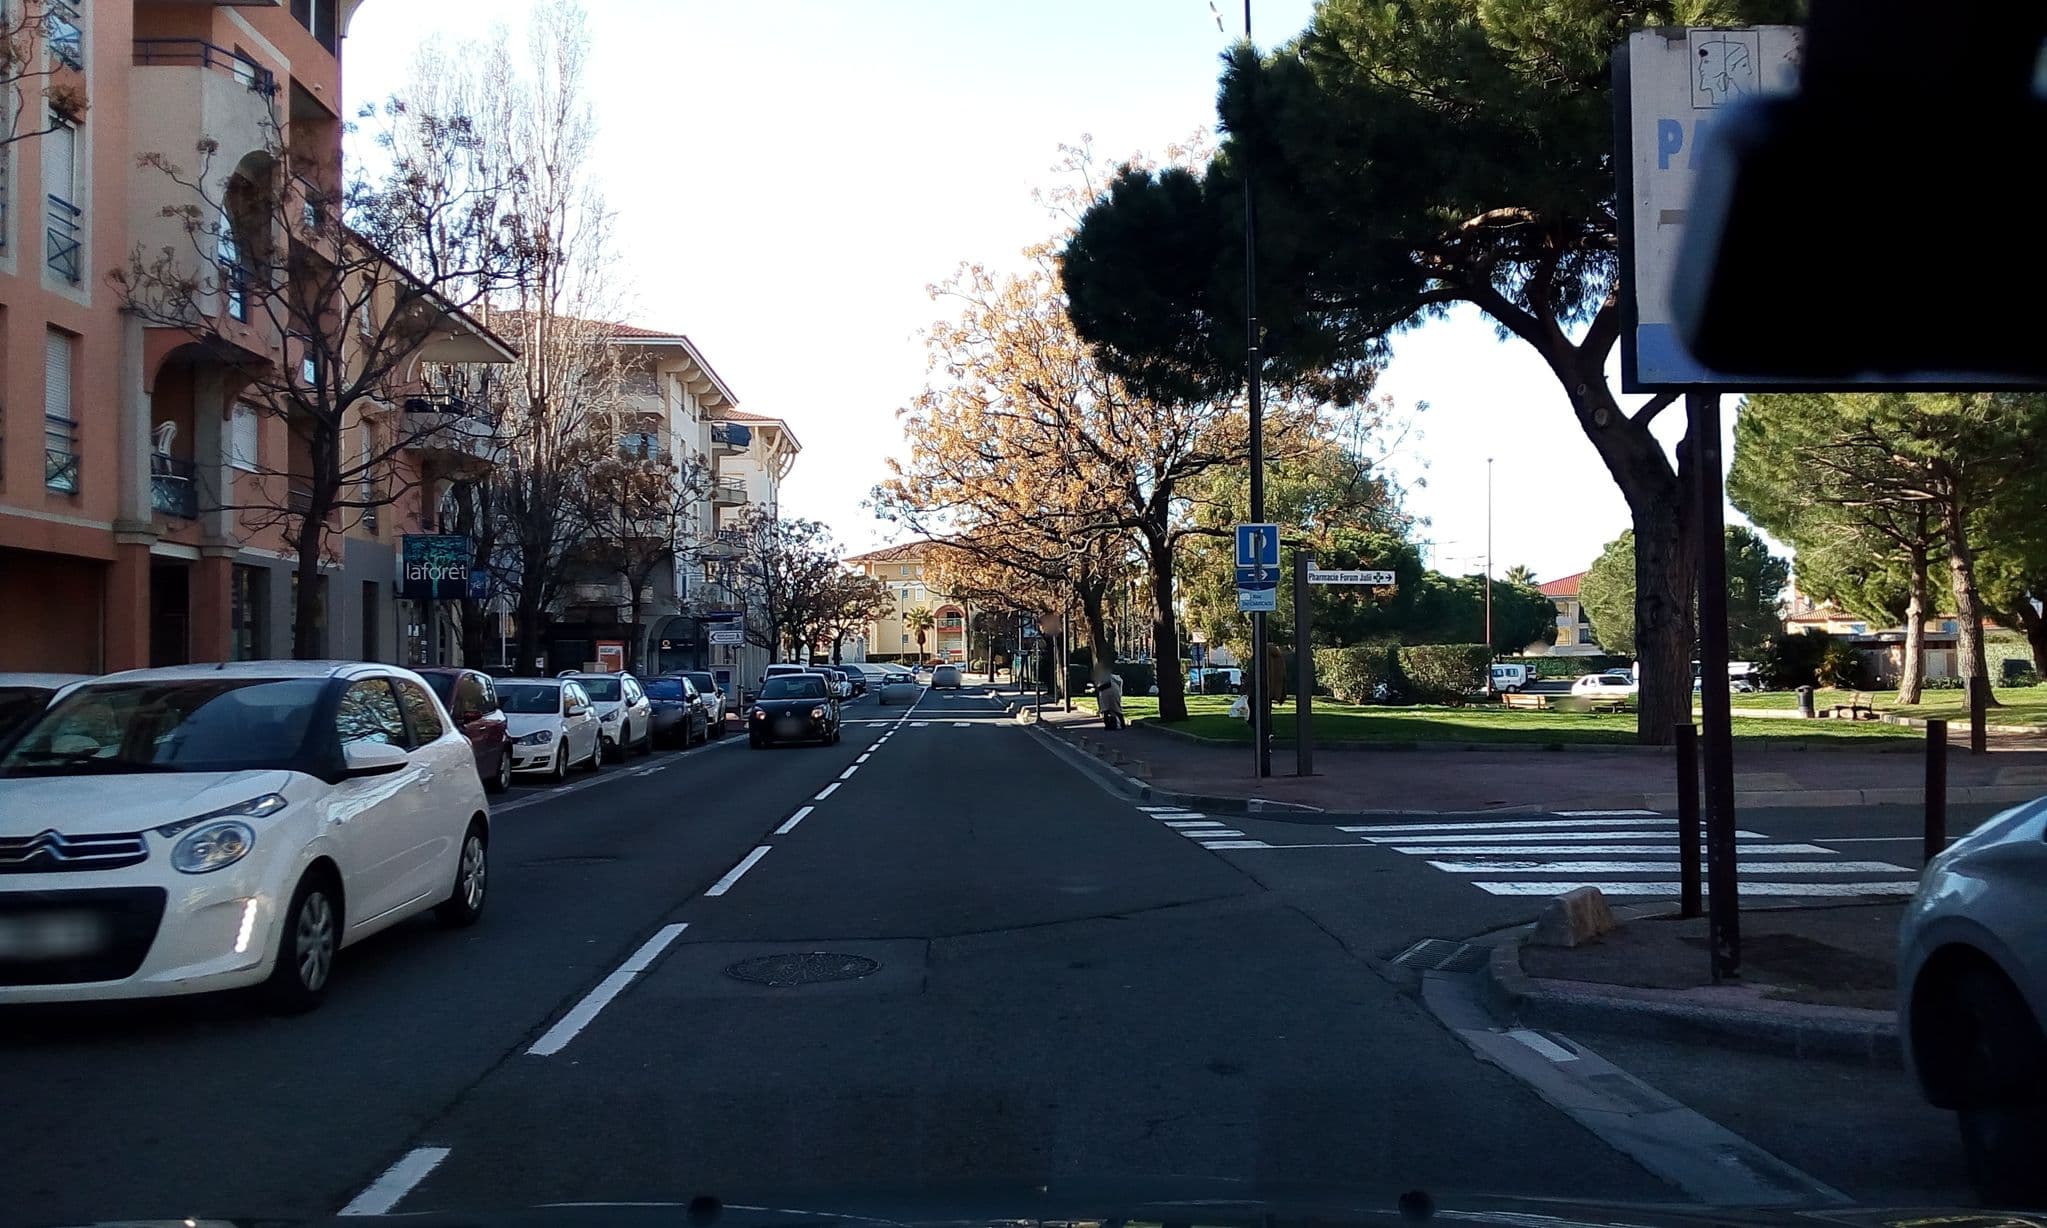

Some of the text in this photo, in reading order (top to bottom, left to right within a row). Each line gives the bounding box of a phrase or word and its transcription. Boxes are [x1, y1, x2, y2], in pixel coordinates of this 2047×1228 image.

[406, 562, 468, 580] laforêt
[1308, 573, 1339, 582] Pharmacie
[1340, 573, 1359, 582] Forum
